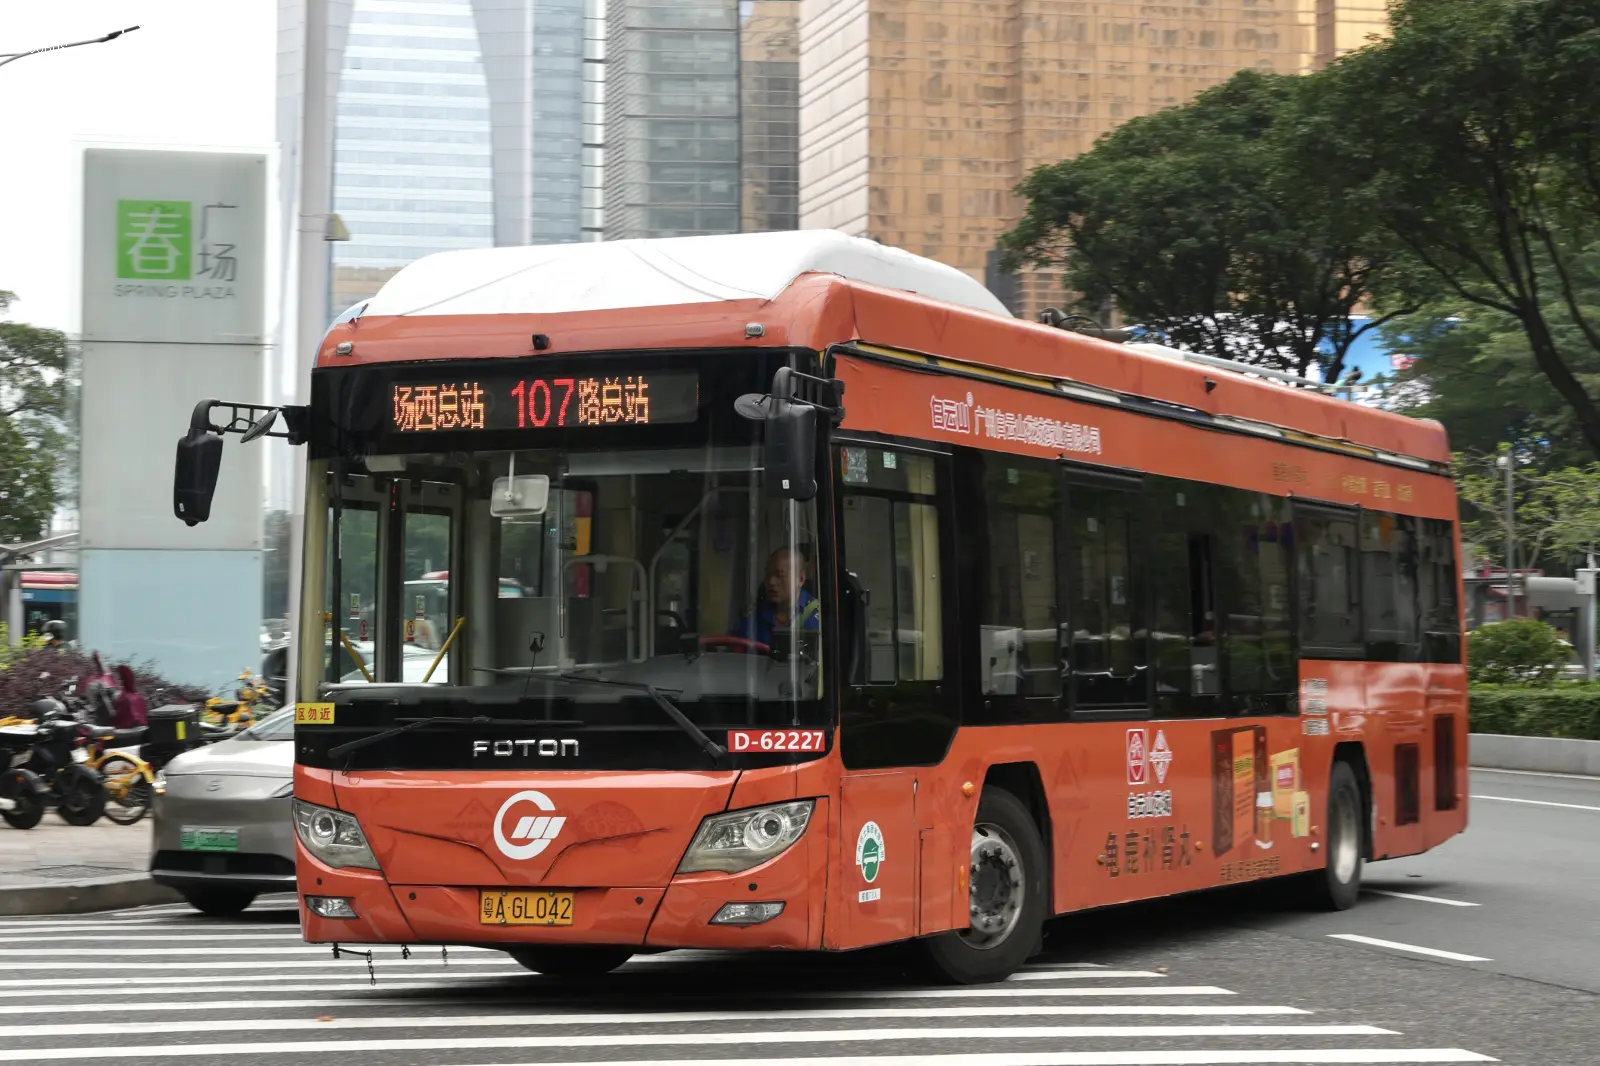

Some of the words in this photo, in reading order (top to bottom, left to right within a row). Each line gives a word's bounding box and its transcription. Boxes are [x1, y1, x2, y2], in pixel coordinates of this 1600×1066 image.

[124, 205, 183, 274] 春
[196, 202, 239, 281] 广场
[114, 284, 177, 298] SPRING
[181, 285, 236, 300] PLAZA
[393, 382, 484, 431] 场西总站
[511, 378, 575, 427] 107
[578, 376, 649, 425] 路总站
[294, 707, 331, 721] 区勿近
[472, 739, 579, 757] FOTON
[734, 732, 824, 750] D-62227
